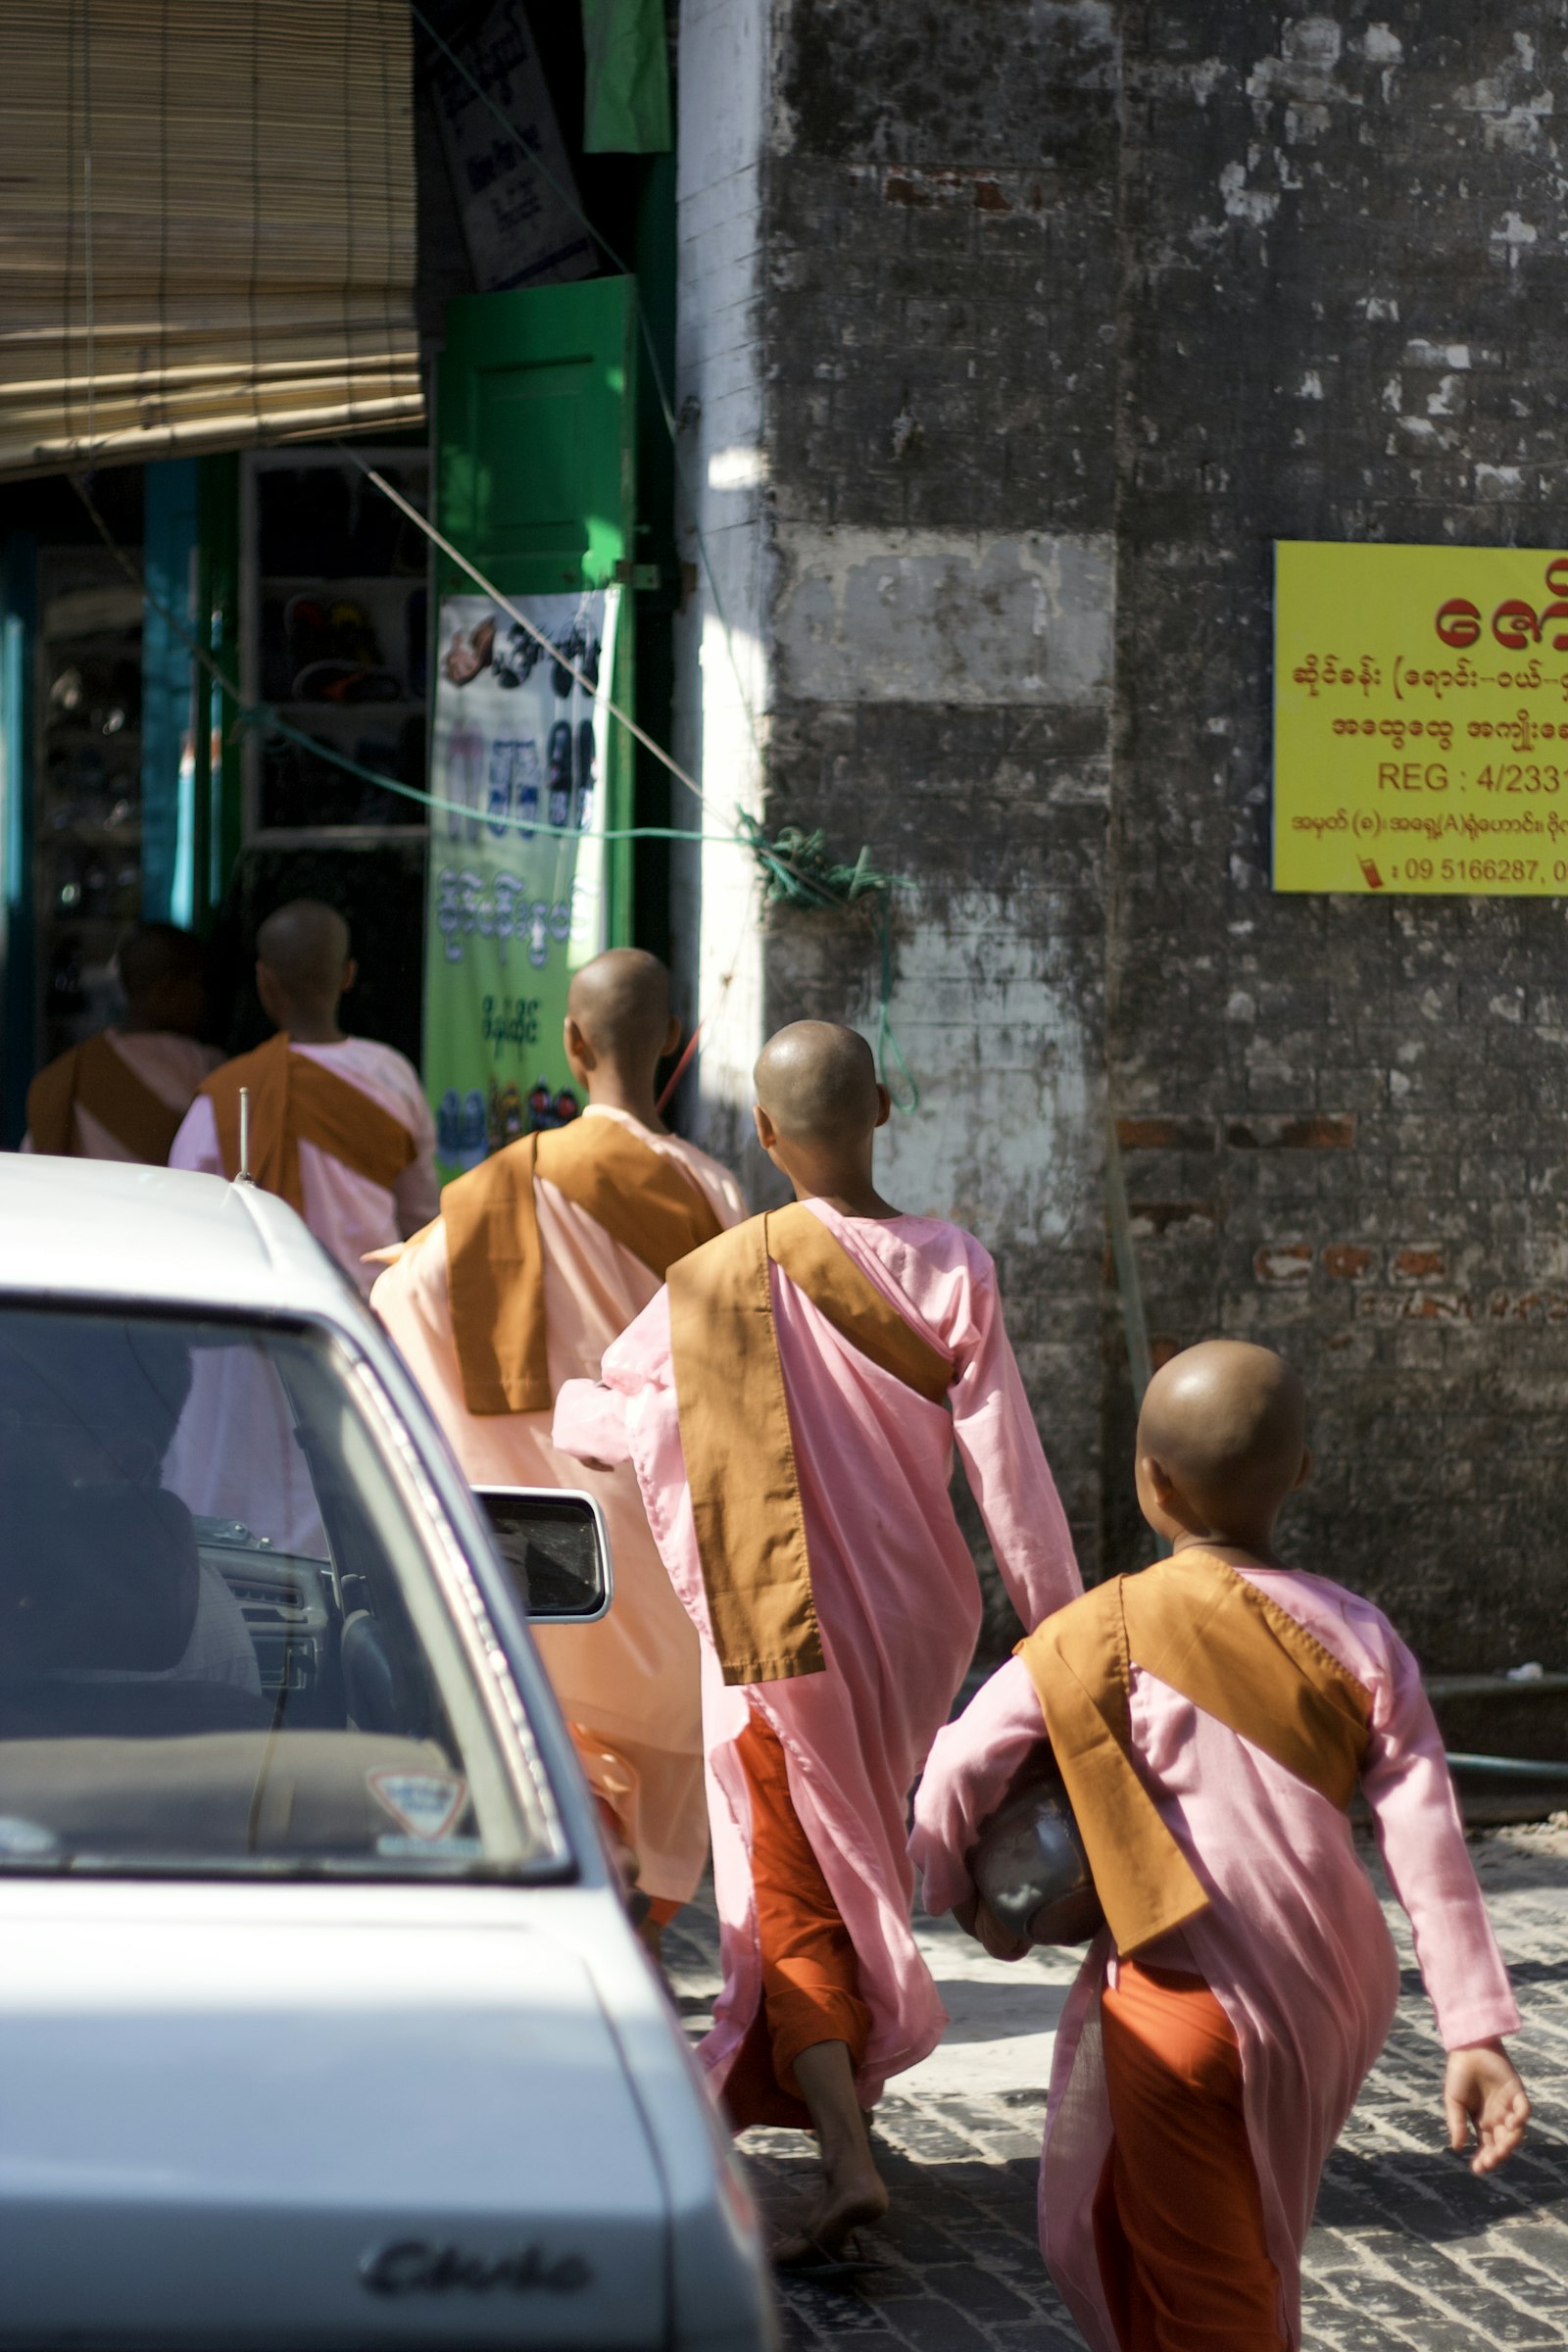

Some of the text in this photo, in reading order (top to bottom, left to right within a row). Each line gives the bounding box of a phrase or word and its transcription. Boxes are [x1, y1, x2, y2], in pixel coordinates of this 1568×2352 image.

[1333, 718, 1453, 751] အထွေထွေ
[1379, 762, 1448, 791] REG
[1405, 858, 1433, 880] 09
[1442, 859, 1545, 885] 5166287,
